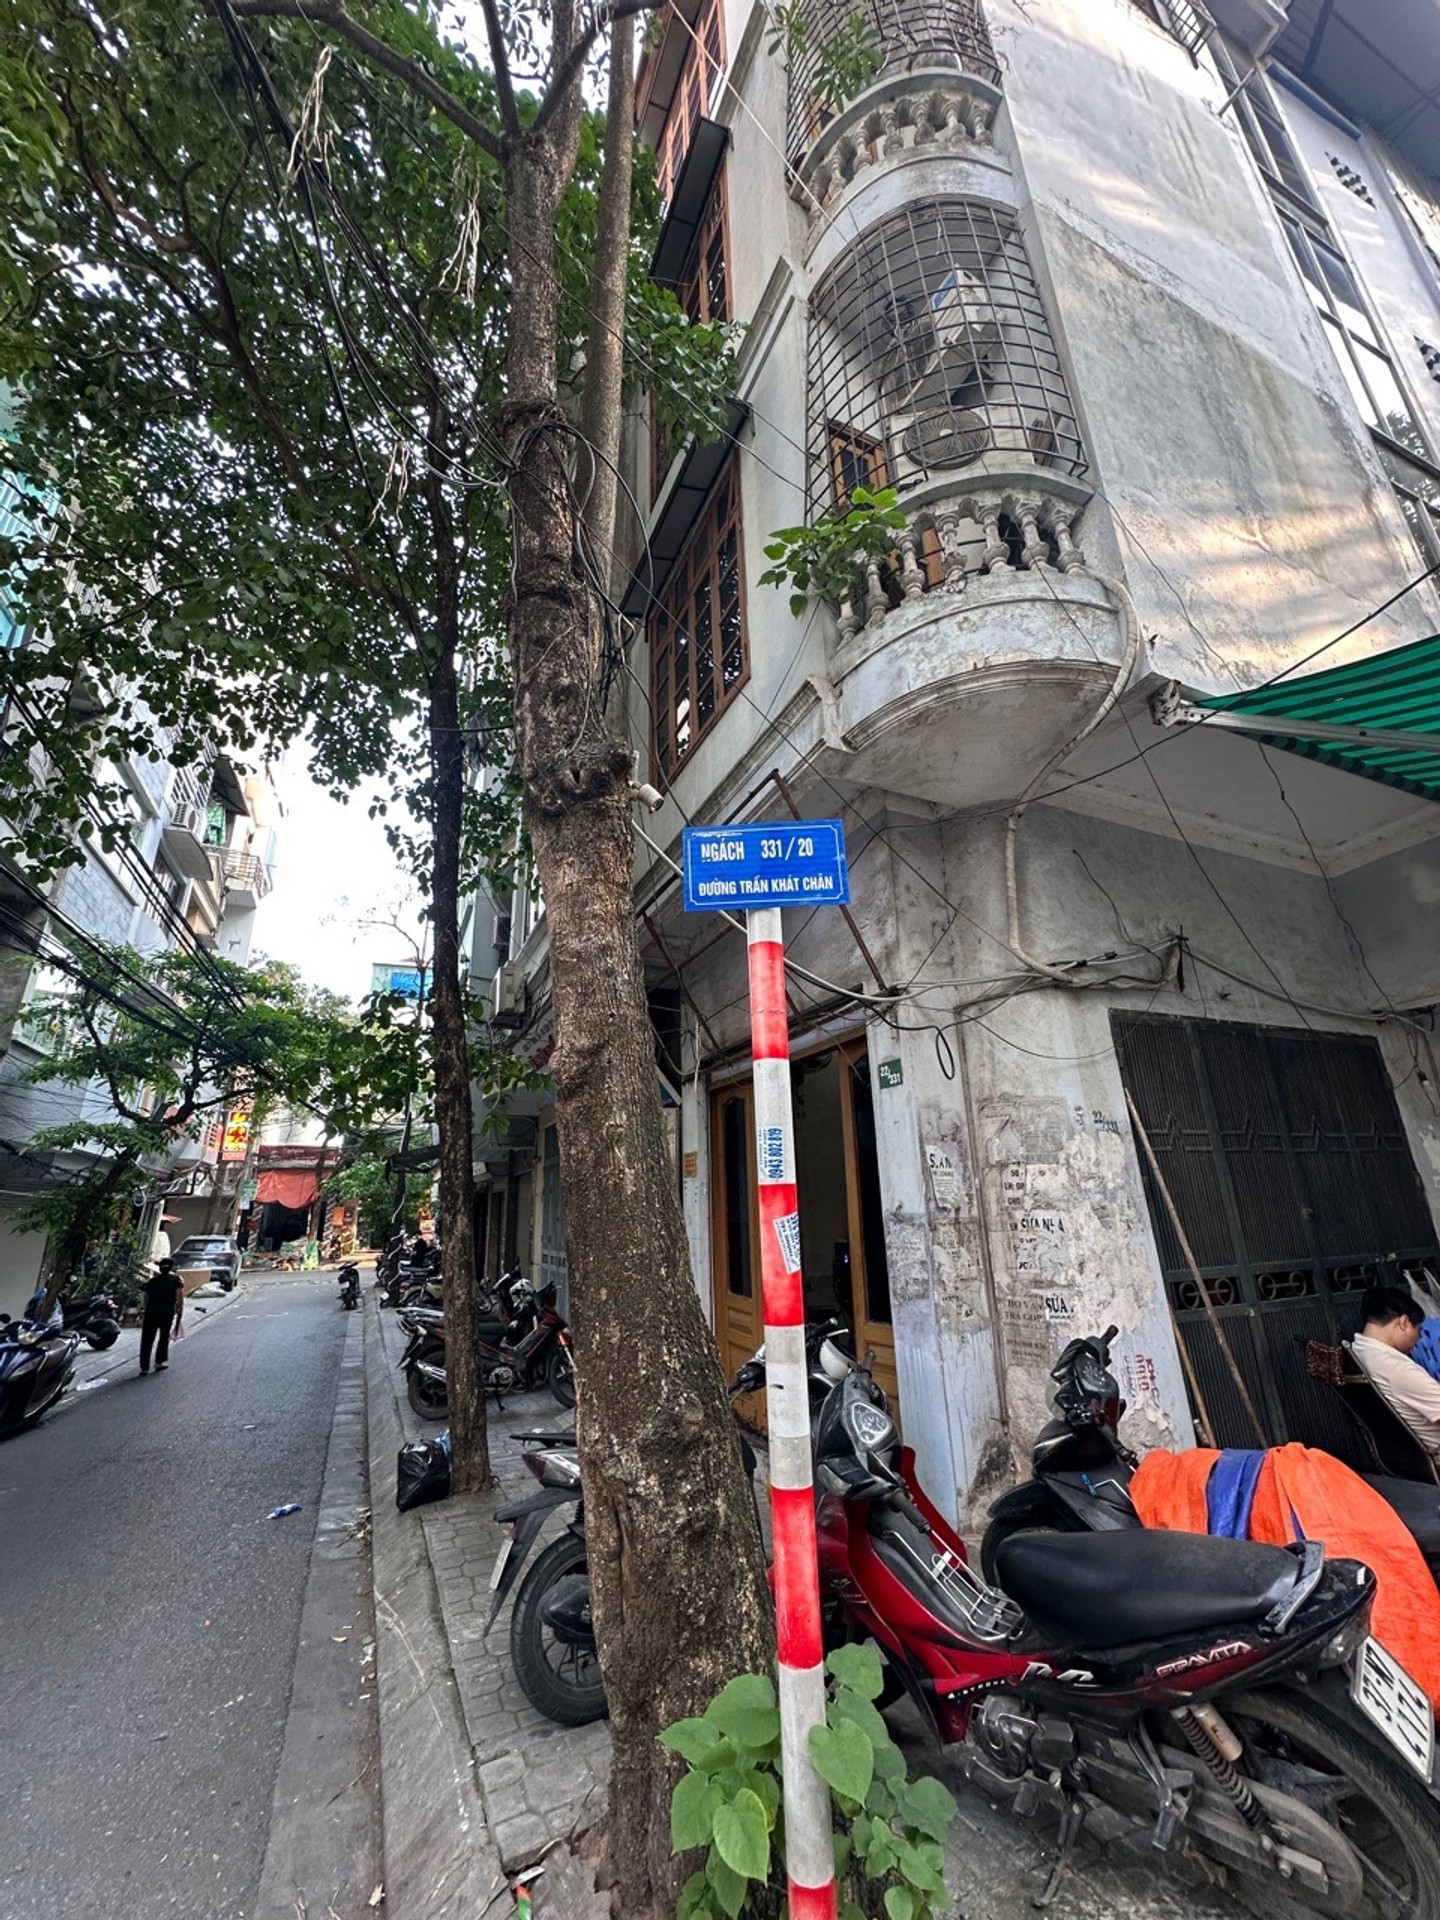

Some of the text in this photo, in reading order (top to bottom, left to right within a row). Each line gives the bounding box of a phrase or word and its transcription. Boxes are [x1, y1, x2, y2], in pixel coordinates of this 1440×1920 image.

[701, 838, 745, 861] NGÁCH
[699, 877, 736, 896] ĐƯỜNG
[802, 872, 833, 891] CHÂN
